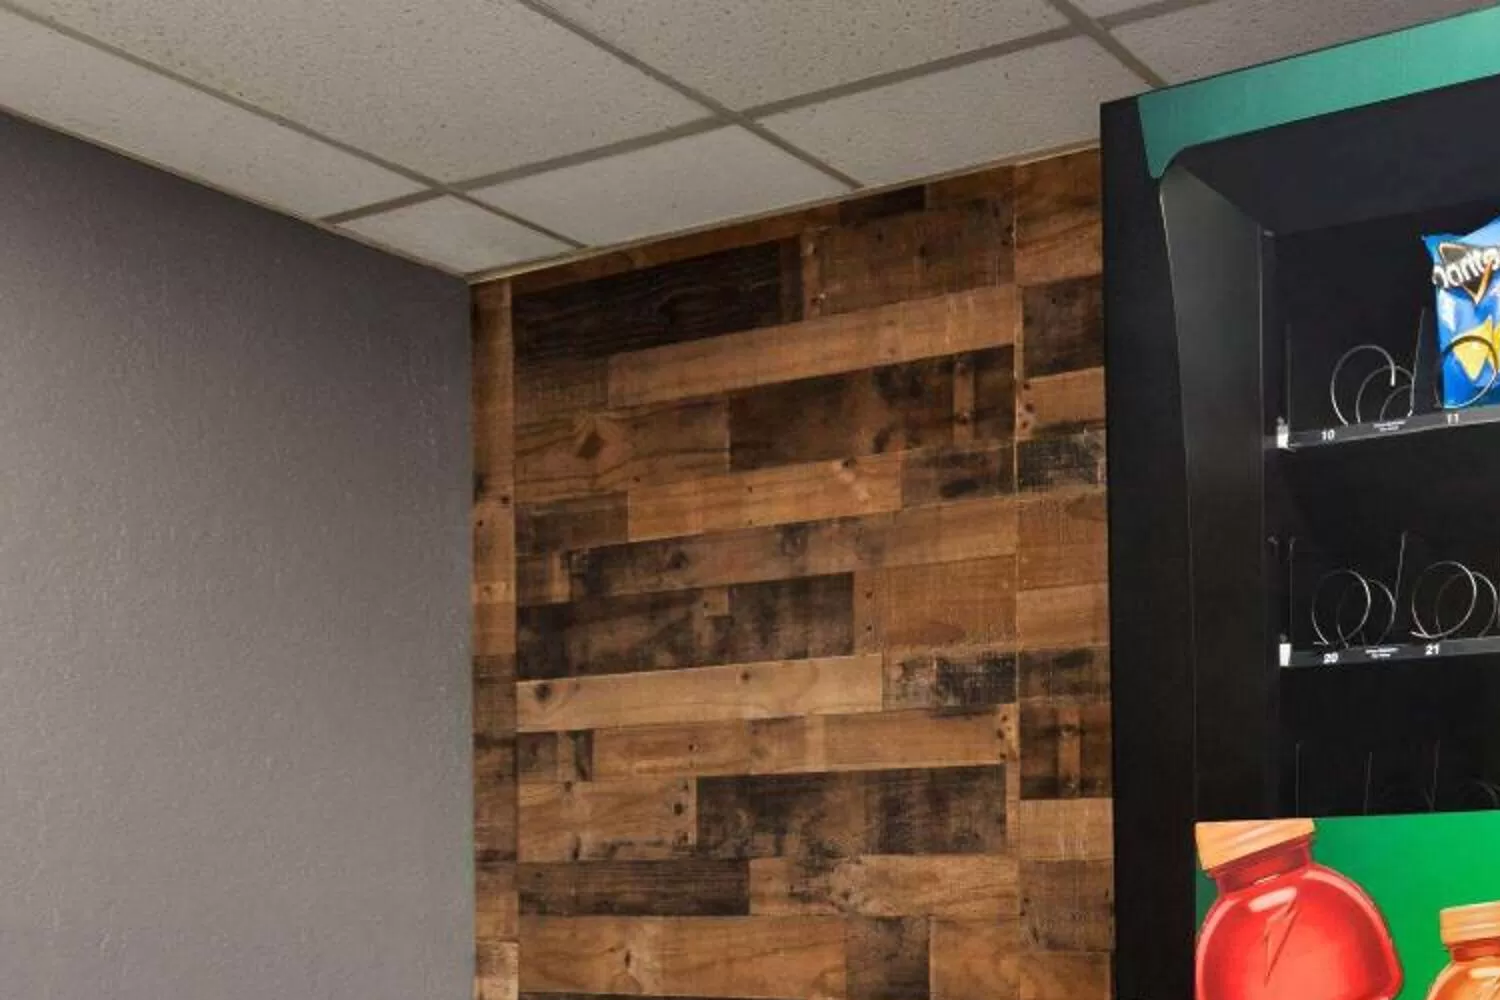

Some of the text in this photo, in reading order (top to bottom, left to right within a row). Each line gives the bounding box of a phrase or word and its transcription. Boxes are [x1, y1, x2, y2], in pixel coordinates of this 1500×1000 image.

[1447, 413, 1459, 424] 11
[1321, 429, 1335, 440] 10
[1425, 643, 1440, 655] 21
